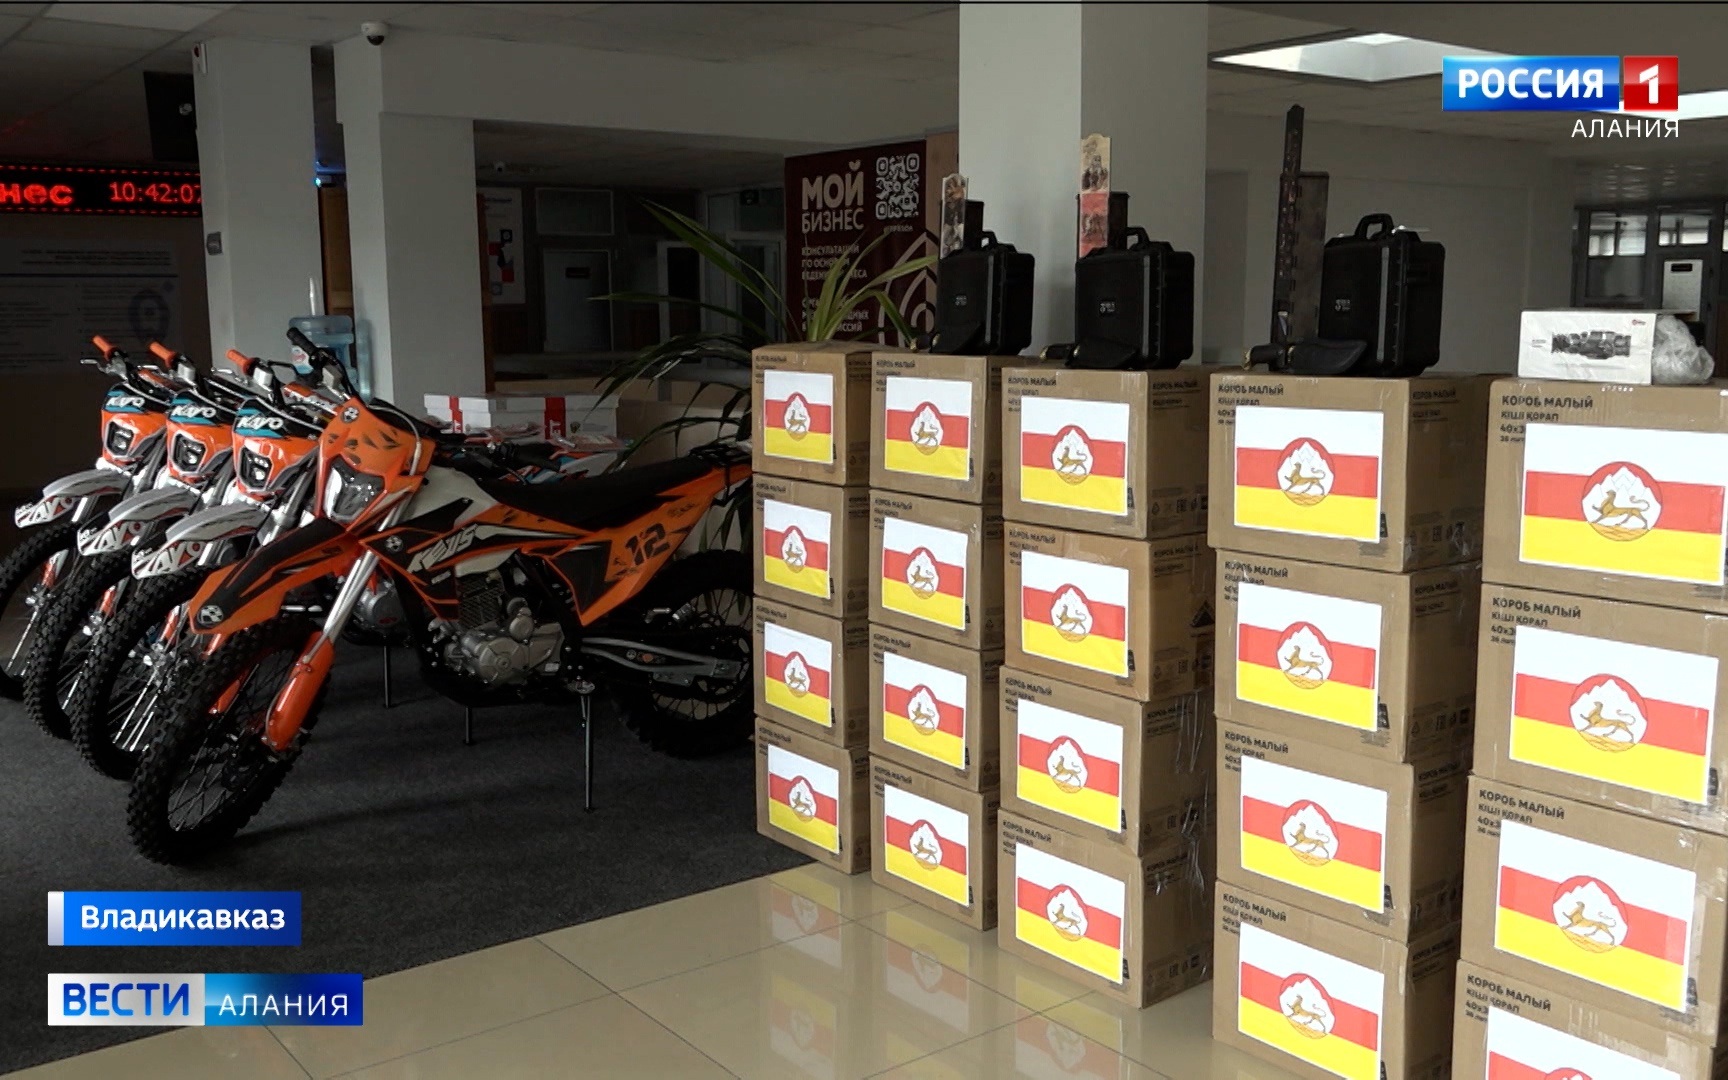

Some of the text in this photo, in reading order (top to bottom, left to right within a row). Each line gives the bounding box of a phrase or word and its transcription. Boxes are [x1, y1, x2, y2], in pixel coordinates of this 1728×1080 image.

[802, 159, 864, 211] МОЙ
[801, 208, 864, 234] БИЗНЕС
[1218, 383, 1284, 395] КОРОБ МАЛЫЙ
[106, 395, 145, 409] KAYO
[172, 404, 216, 419] KAYO
[1502, 395, 1593, 408] КОРОБ МАЛЫЙ
[237, 415, 284, 431] KAYO
[625, 523, 671, 566] 12
[1225, 560, 1288, 578] КОРОБ МАЛЫЙ
[1492, 597, 1581, 619] КОРОБ МАЛЫЙ
[1225, 731, 1289, 754] КОРОБ МАЛЫЙ
[1479, 789, 1565, 819] КОРОБ МАЛЫЙ
[1223, 892, 1287, 921] КОРОБ МАЛЫЙ
[1467, 974, 1551, 1012] КОРОБ МАЛЫЙ
